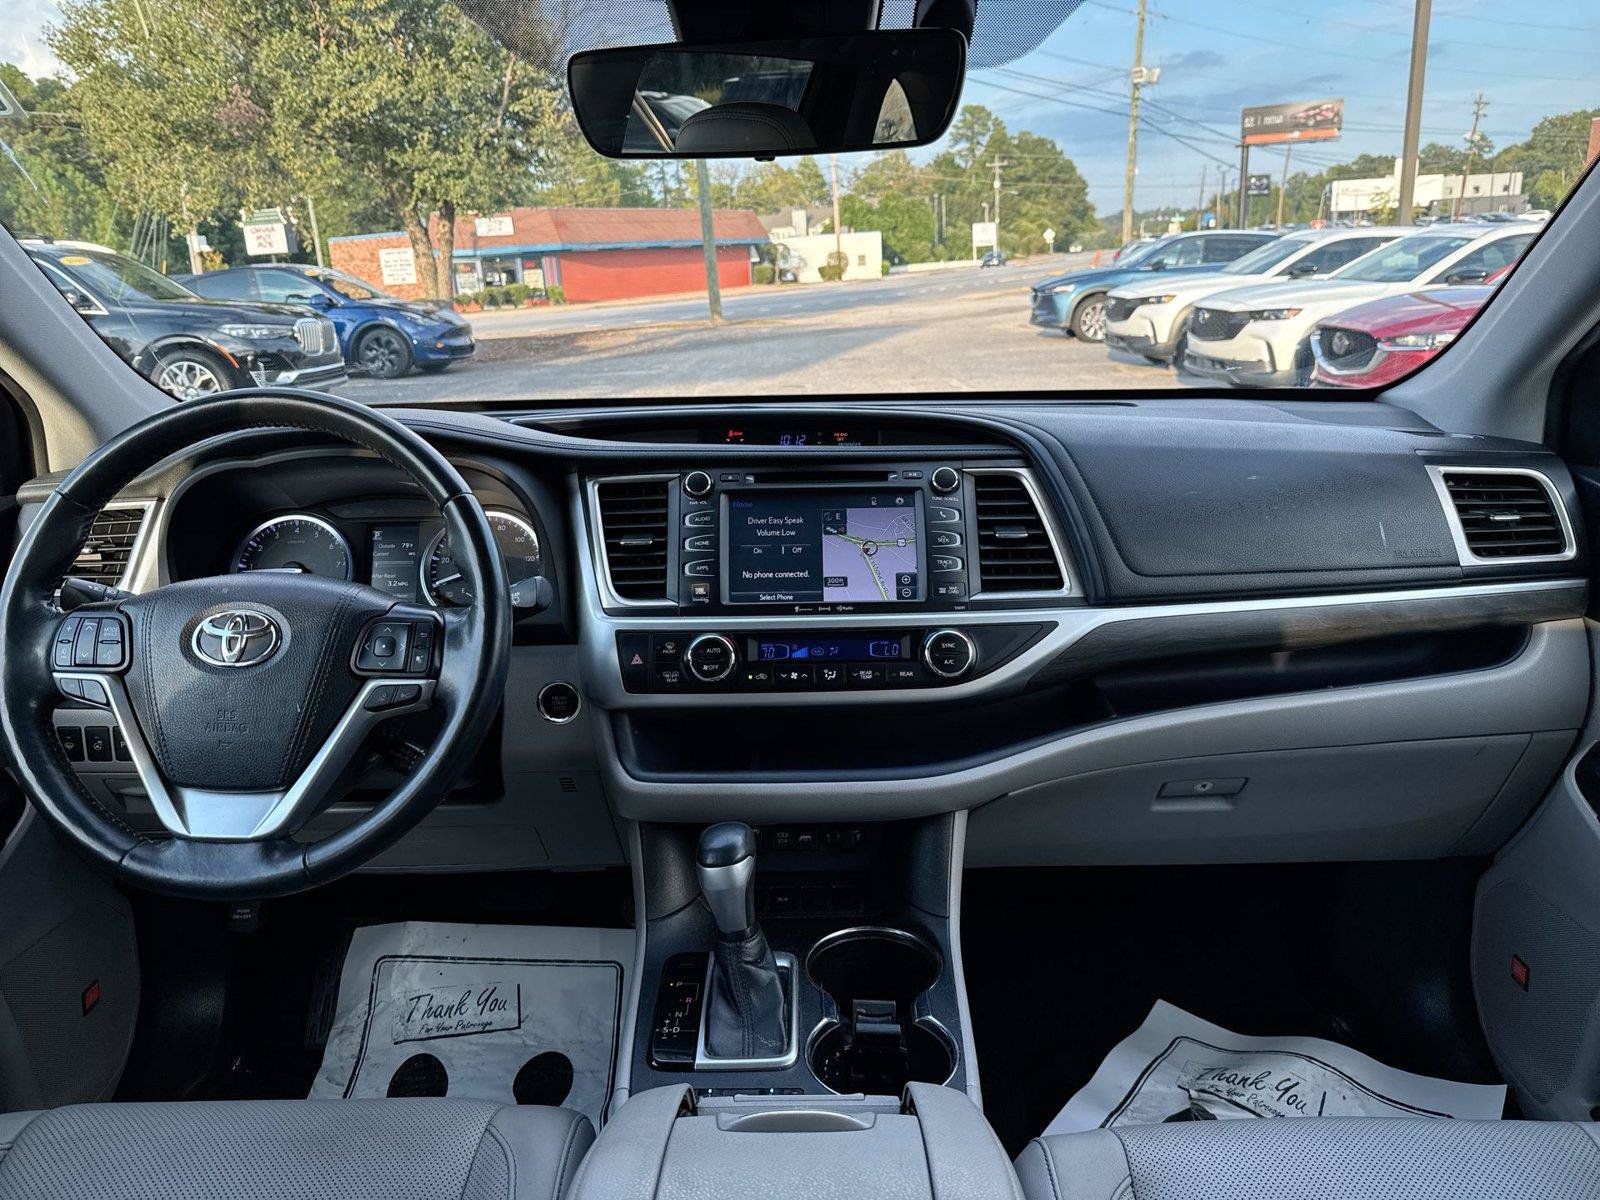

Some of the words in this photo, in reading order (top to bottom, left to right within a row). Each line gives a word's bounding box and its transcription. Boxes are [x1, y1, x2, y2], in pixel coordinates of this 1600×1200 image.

[747, 516, 767, 524] Driver
[768, 516, 783, 525] Easy
[784, 516, 804, 525] Speak
[374, 532, 382, 540] P
[742, 571, 753, 579] No
[753, 571, 774, 580] phone
[774, 570, 810, 578] connected.
[406, 989, 472, 1023] Thank
[476, 986, 507, 1016] You
[418, 1024, 434, 1034] For
[1195, 1067, 1272, 1091] Thank
[1274, 1077, 1308, 1115] You
